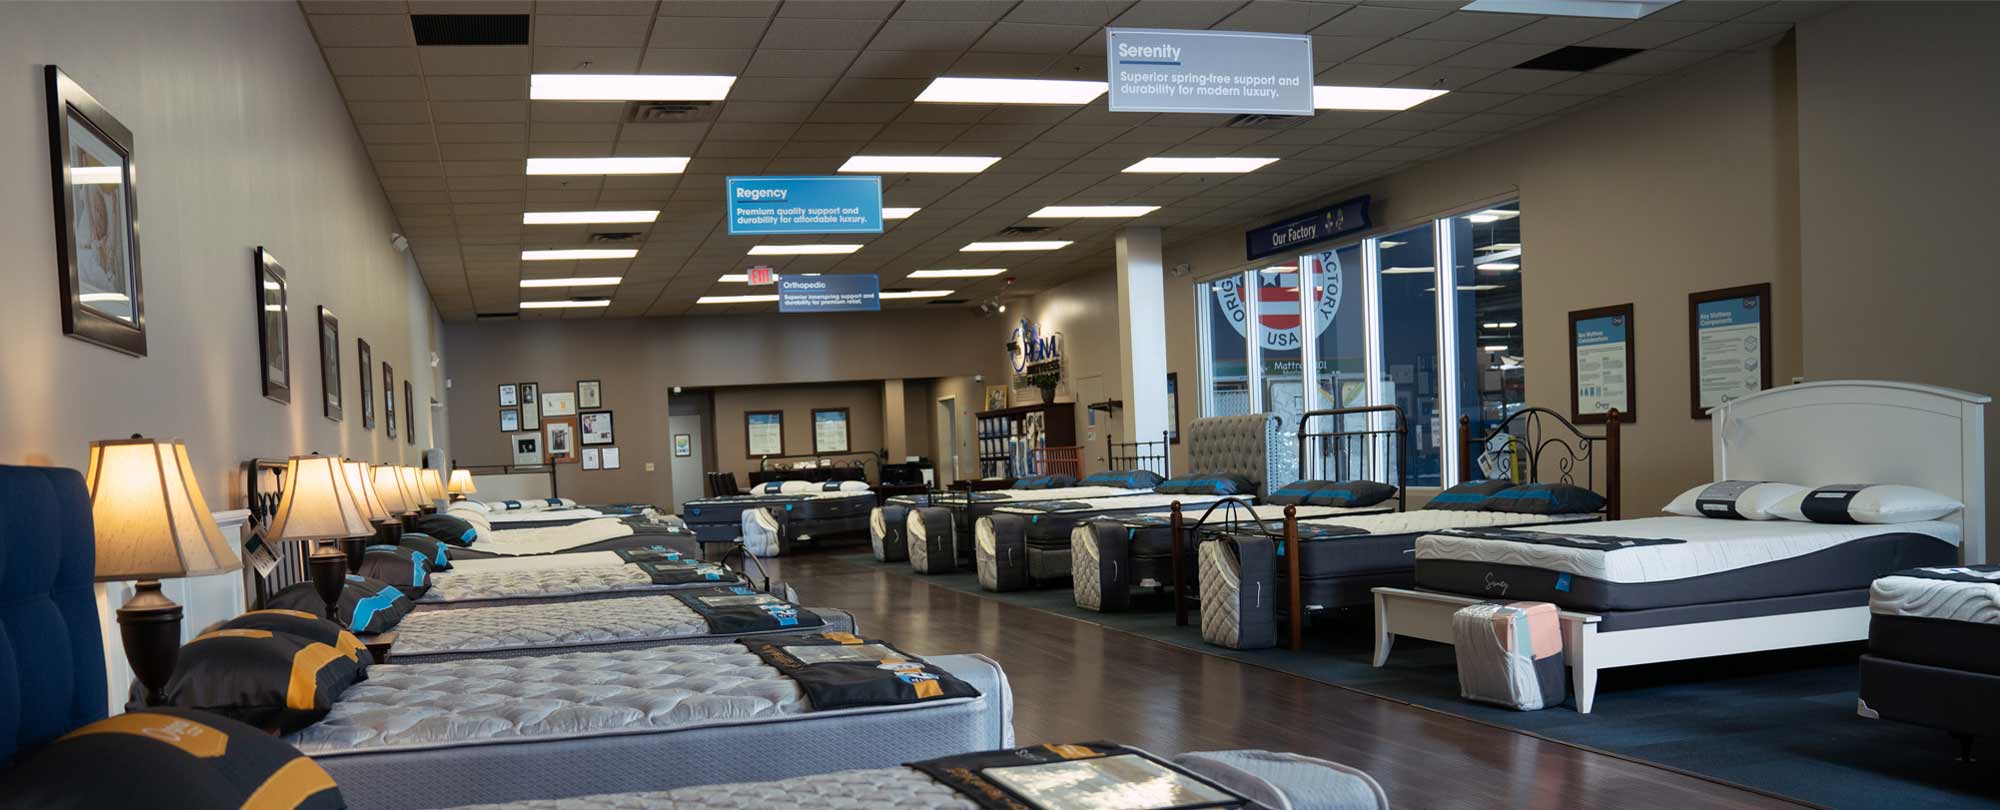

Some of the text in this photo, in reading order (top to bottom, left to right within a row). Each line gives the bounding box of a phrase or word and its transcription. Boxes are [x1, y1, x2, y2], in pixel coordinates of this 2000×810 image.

[1118, 42, 1181, 61] Serenity
[1120, 71, 1300, 89] Superior spring-free support and
[1121, 83, 1280, 99] durability for modern luxury.
[736, 187, 788, 200] Regency
[737, 207, 859, 217] Premium quality support and
[737, 215, 868, 225] durability for affordable luxury.
[1272, 224, 1317, 247] Our Factory
[783, 281, 826, 290] Orthopedic
[1320, 250, 1339, 320] ACTORY
[1267, 331, 1299, 347] USA
[1273, 361, 1303, 370] Mattr
